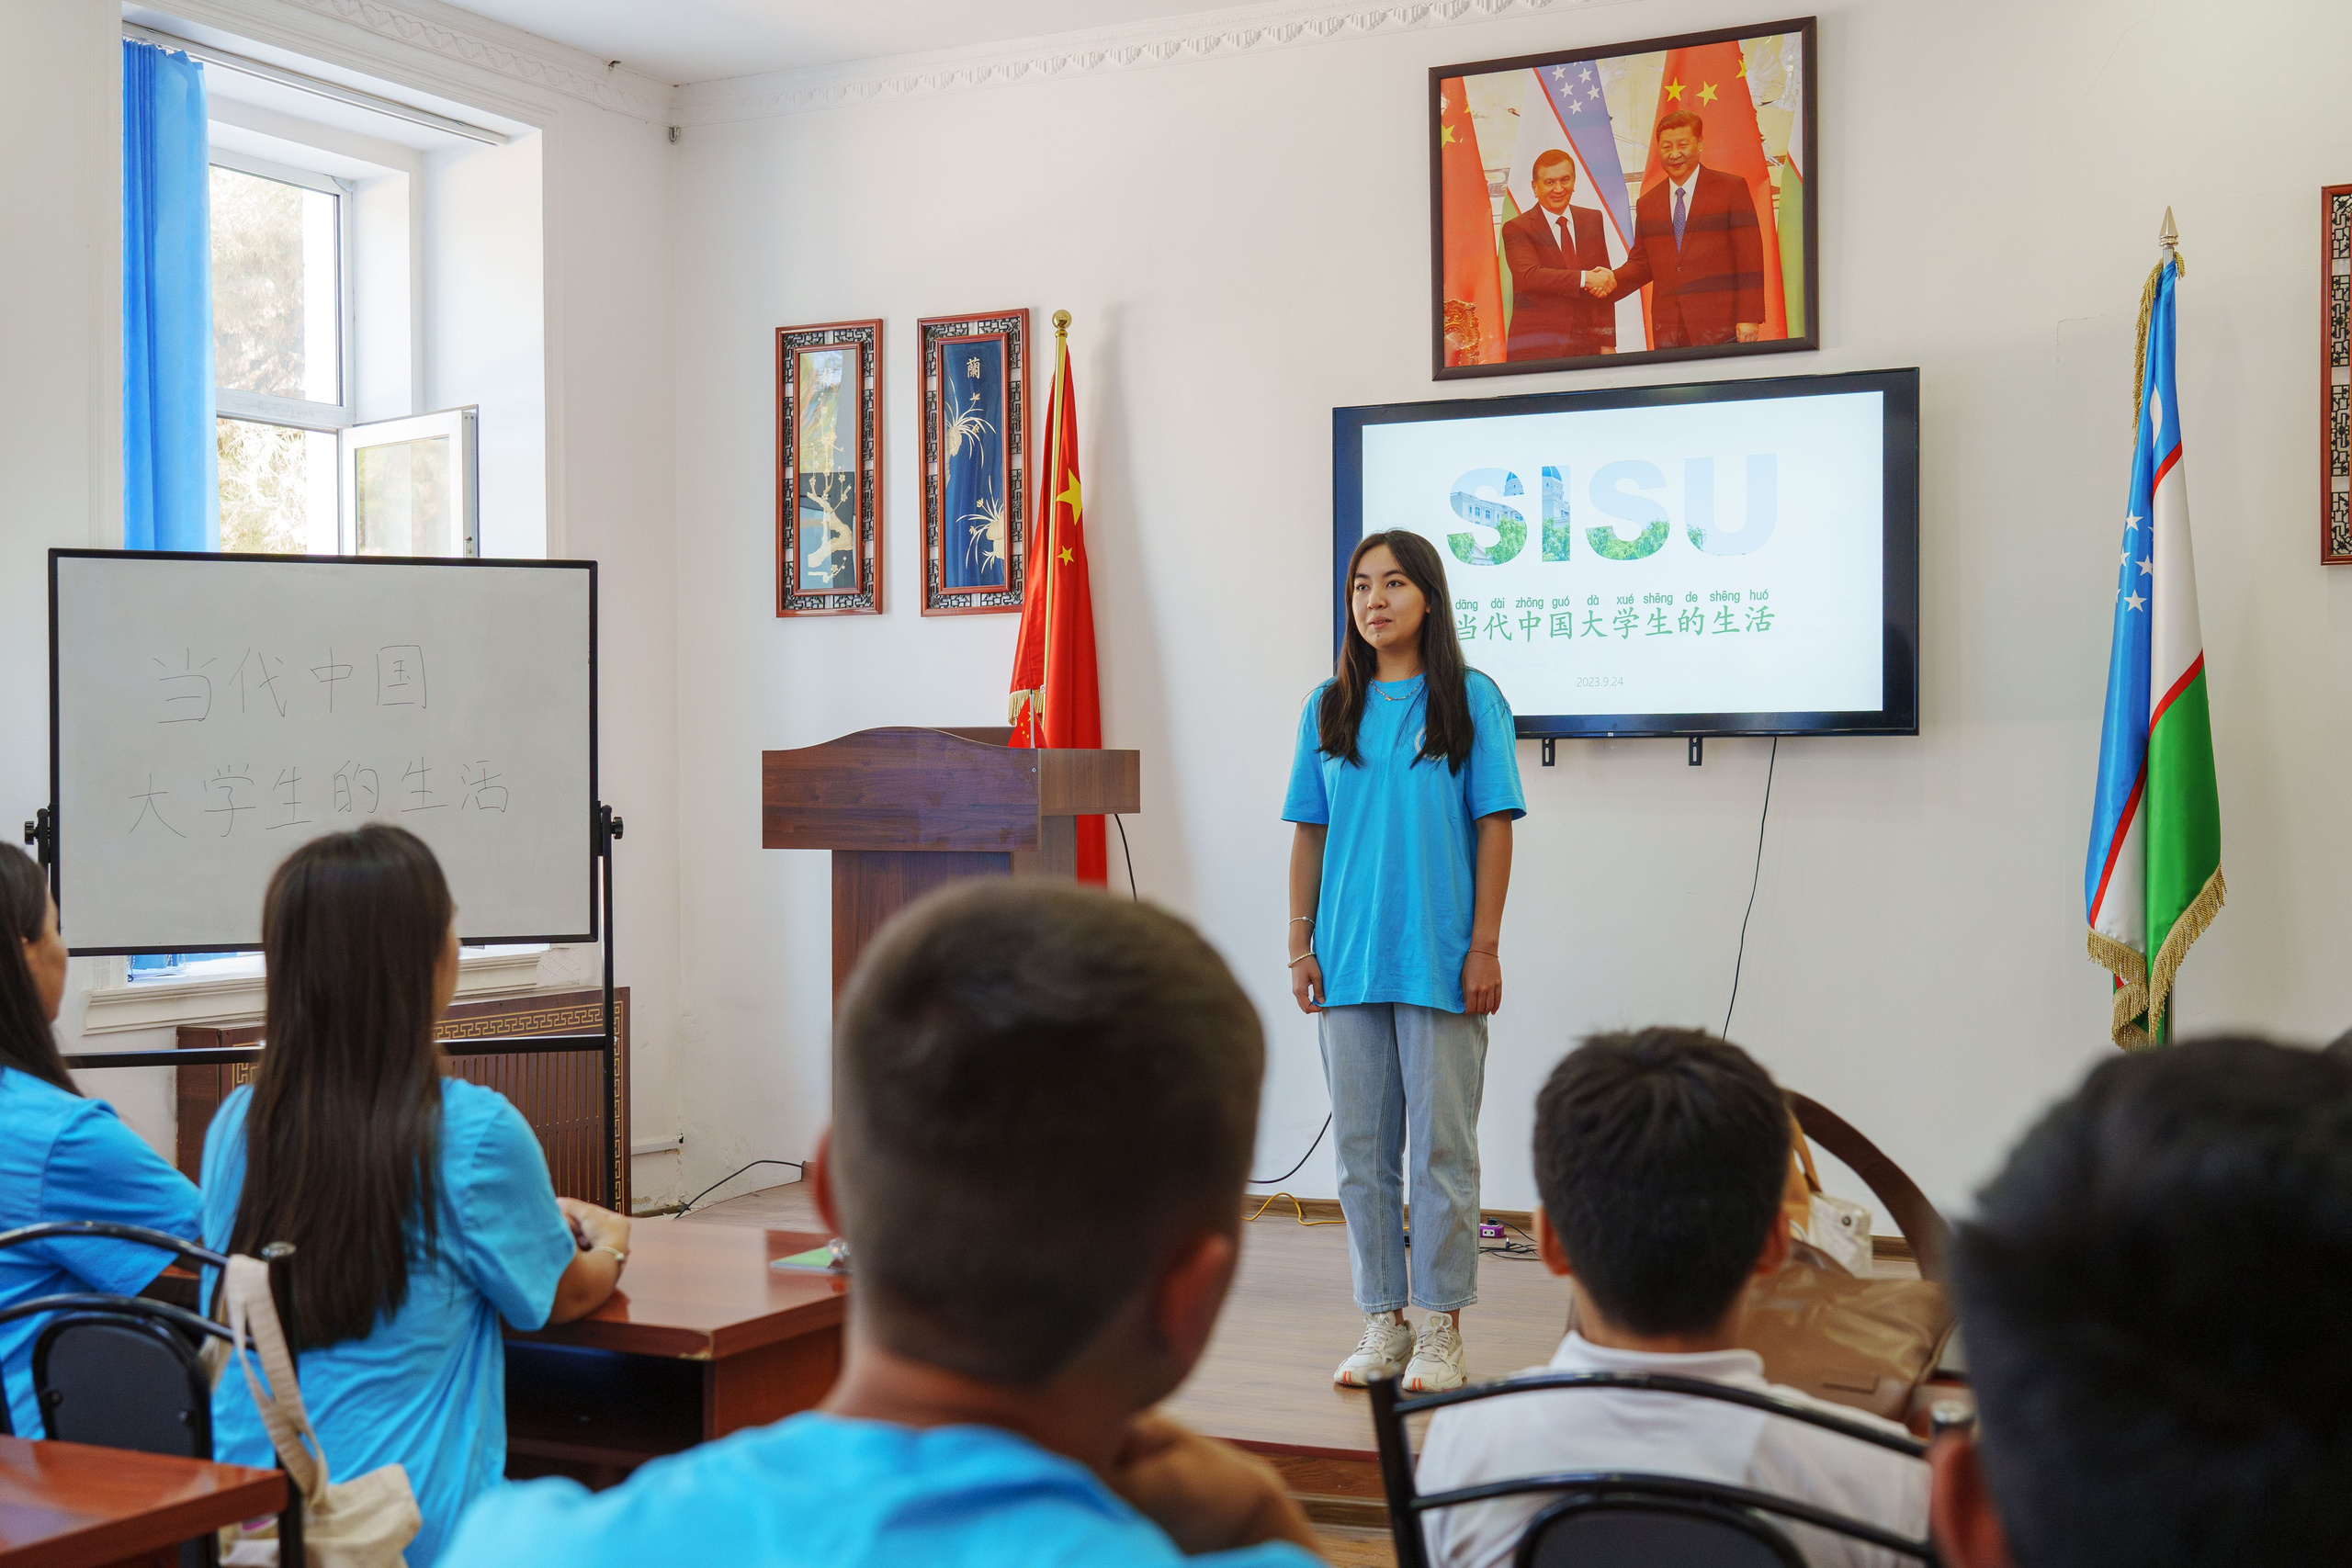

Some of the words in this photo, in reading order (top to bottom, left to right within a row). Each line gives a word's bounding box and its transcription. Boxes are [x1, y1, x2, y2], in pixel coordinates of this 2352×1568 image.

[1446, 453, 1778, 567] SISU
[1455, 599, 1478, 612] dāng
[1490, 597, 1505, 609] dài
[1516, 597, 1544, 610] zhōng
[1552, 595, 1570, 609] guó
[1587, 594, 1600, 606] dà
[1616, 593, 1634, 605] xué
[1643, 592, 1674, 605] shēng
[1685, 591, 1698, 603] de
[1709, 590, 1741, 604] shēng
[1749, 589, 1770, 601] huó
[1457, 605, 1775, 642] 当代中国大学生的生活
[153, 645, 427, 724] 当代中国
[1577, 676, 1624, 687] 2023.9.24
[129, 756, 509, 838] 大学生的生活
